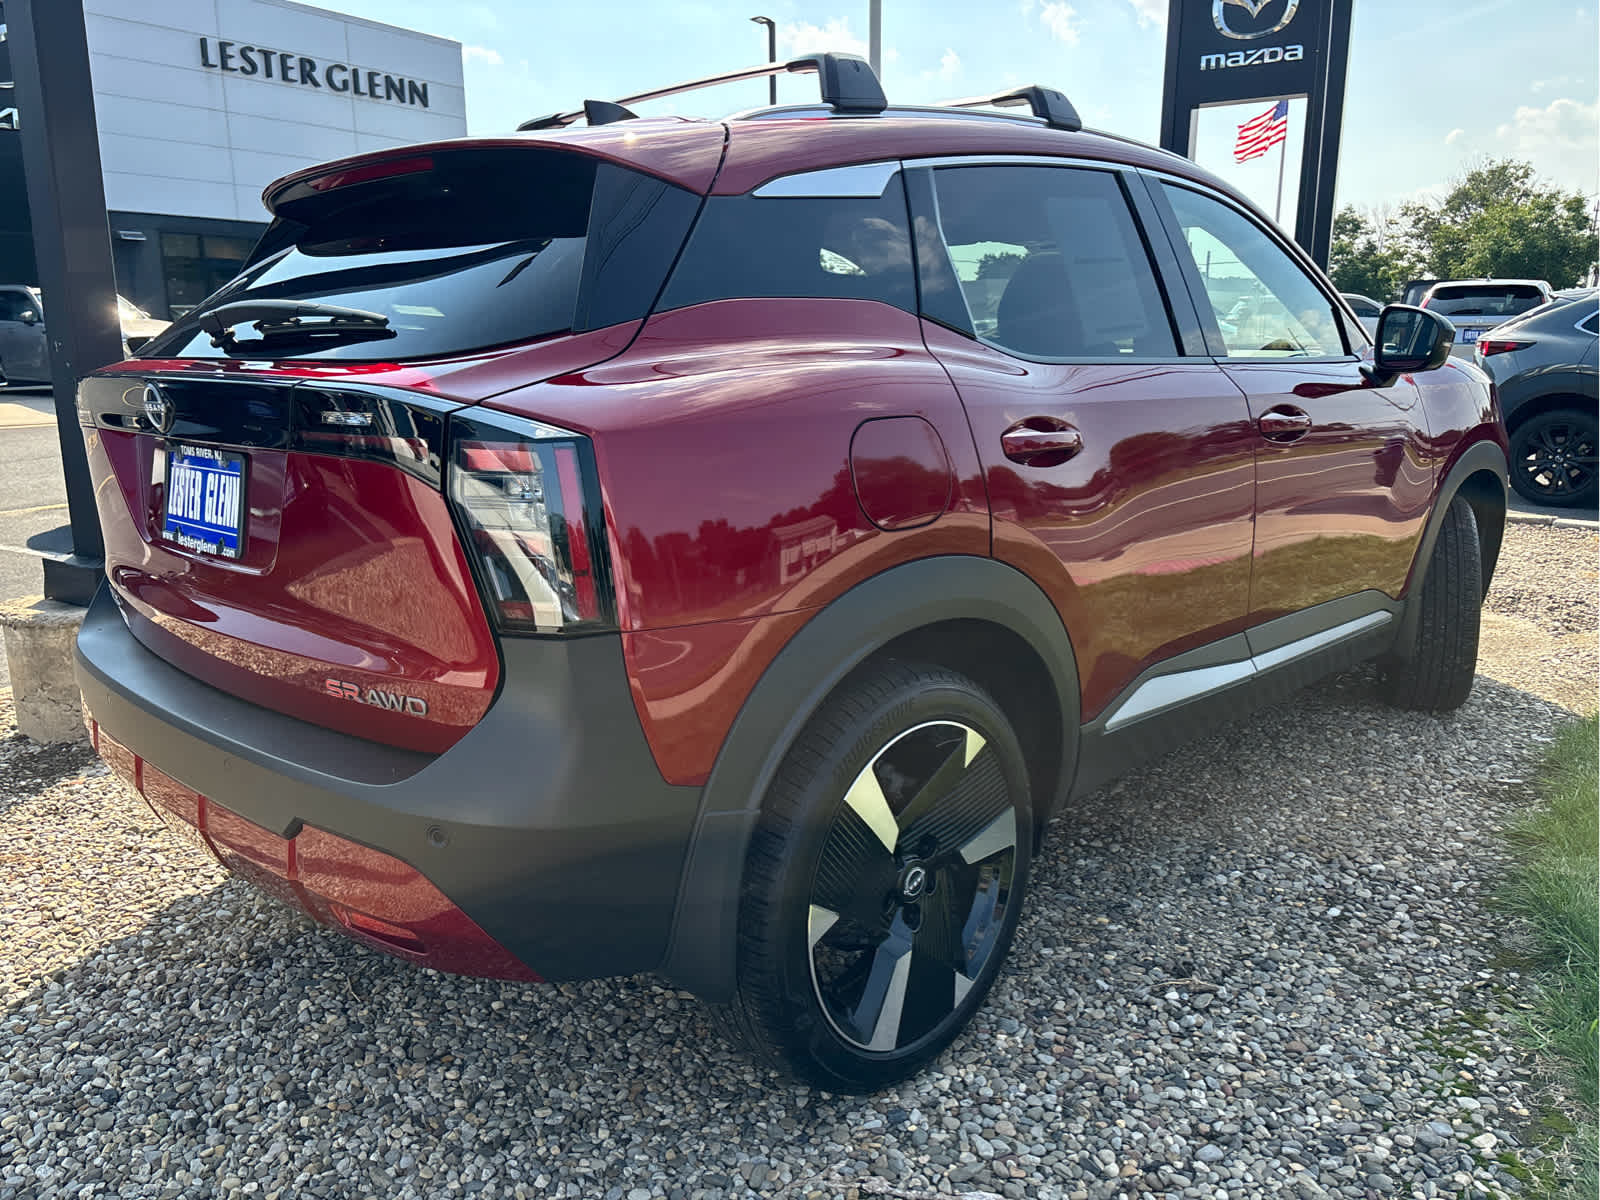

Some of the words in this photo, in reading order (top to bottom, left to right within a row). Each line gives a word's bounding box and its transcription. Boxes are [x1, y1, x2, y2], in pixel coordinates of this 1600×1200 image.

[200, 37, 321, 88] LESTER
[325, 63, 430, 108] GLENN
[214, 449, 222, 460] NJ
[168, 467, 202, 520] LESTER
[205, 472, 240, 528] GLENN
[177, 532, 217, 555] lesterglenn
[326, 679, 366, 704] SR
[367, 689, 427, 717] AWD
